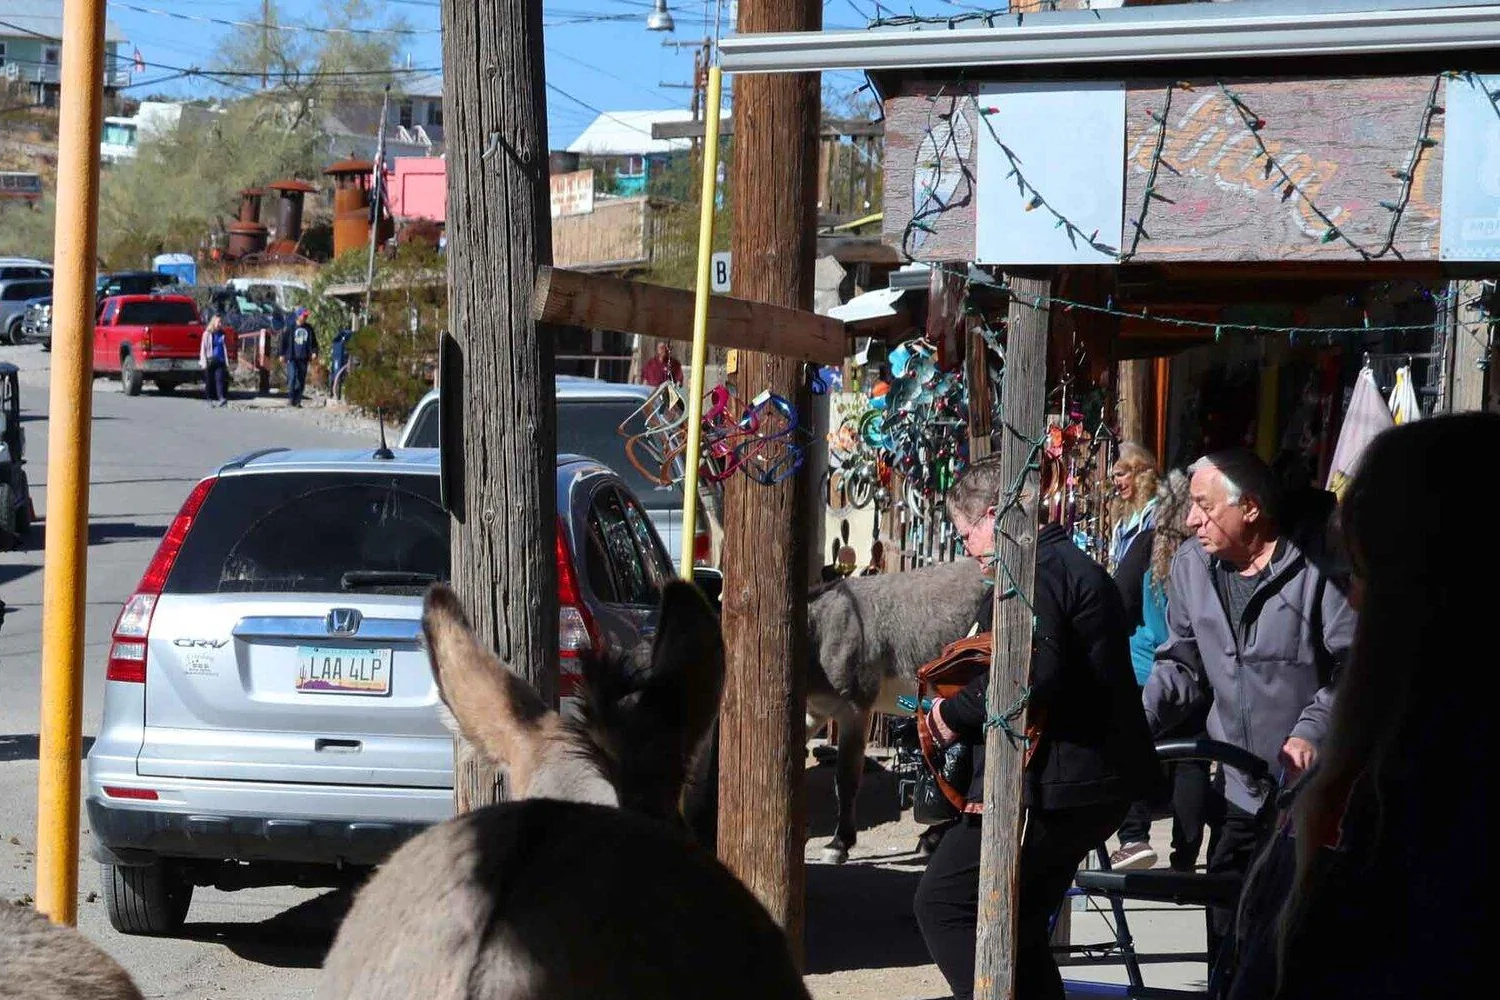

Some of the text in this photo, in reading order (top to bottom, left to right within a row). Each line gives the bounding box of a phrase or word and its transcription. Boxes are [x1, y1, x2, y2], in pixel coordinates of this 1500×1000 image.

[716, 261, 726, 285] B
[310, 657, 382, 681] LAA 4LP
